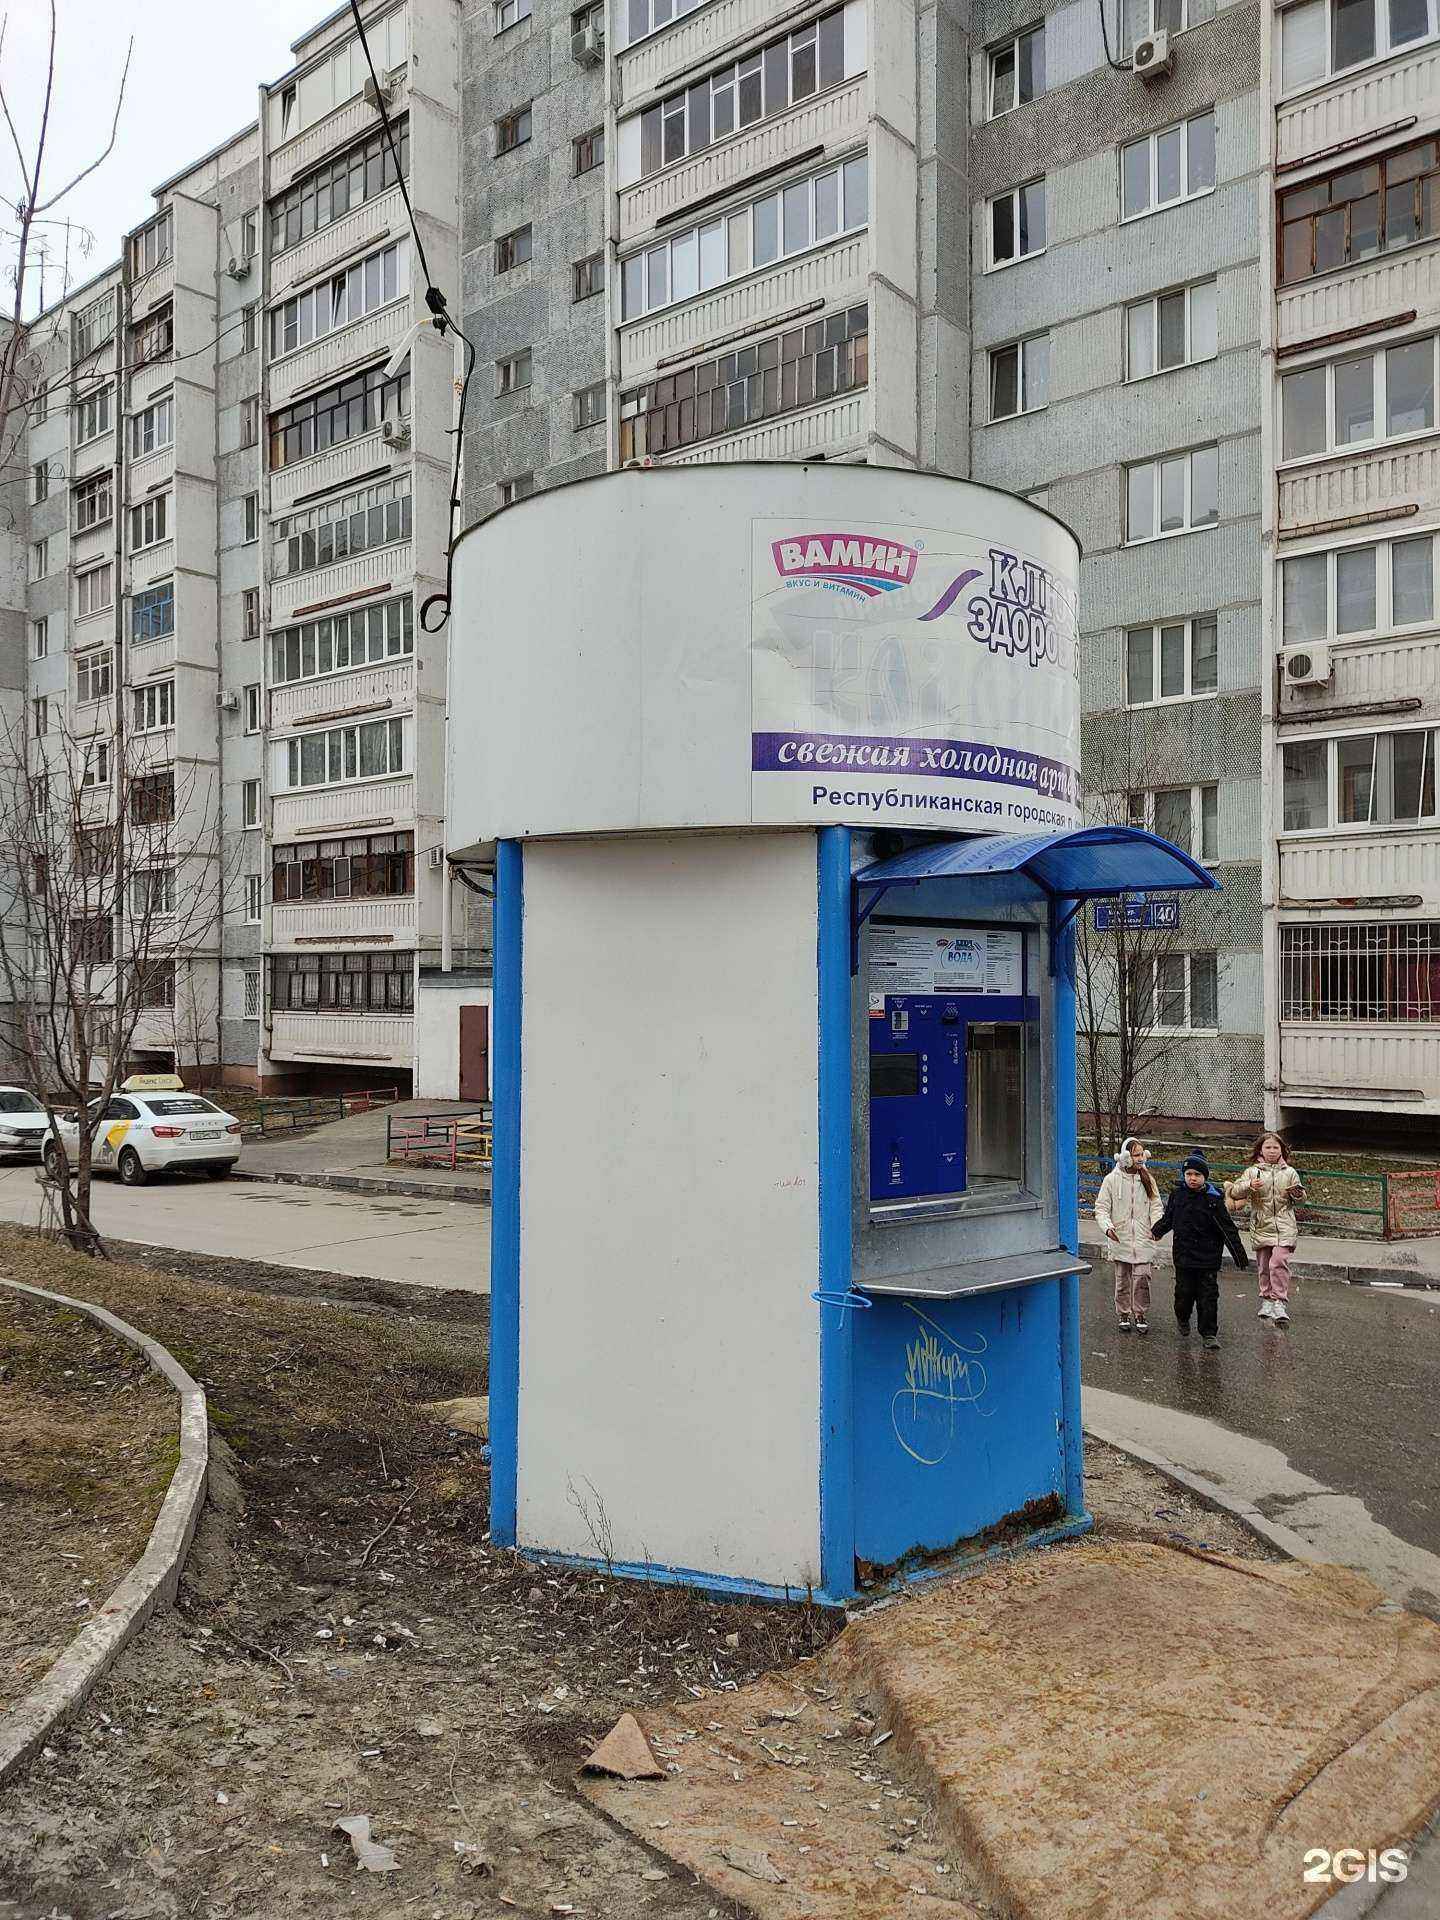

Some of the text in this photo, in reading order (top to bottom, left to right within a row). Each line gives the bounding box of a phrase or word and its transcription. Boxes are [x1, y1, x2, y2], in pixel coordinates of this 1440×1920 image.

[780, 539, 911, 577] ВАМИН
[785, 579, 867, 604] ВКУС И ВИТАМИН
[778, 741, 911, 767] свежая
[919, 746, 1038, 782] холодная
[812, 785, 1003, 816] Республиканская
[1007, 803, 1066, 828] городская
[1157, 906, 1174, 923] 40
